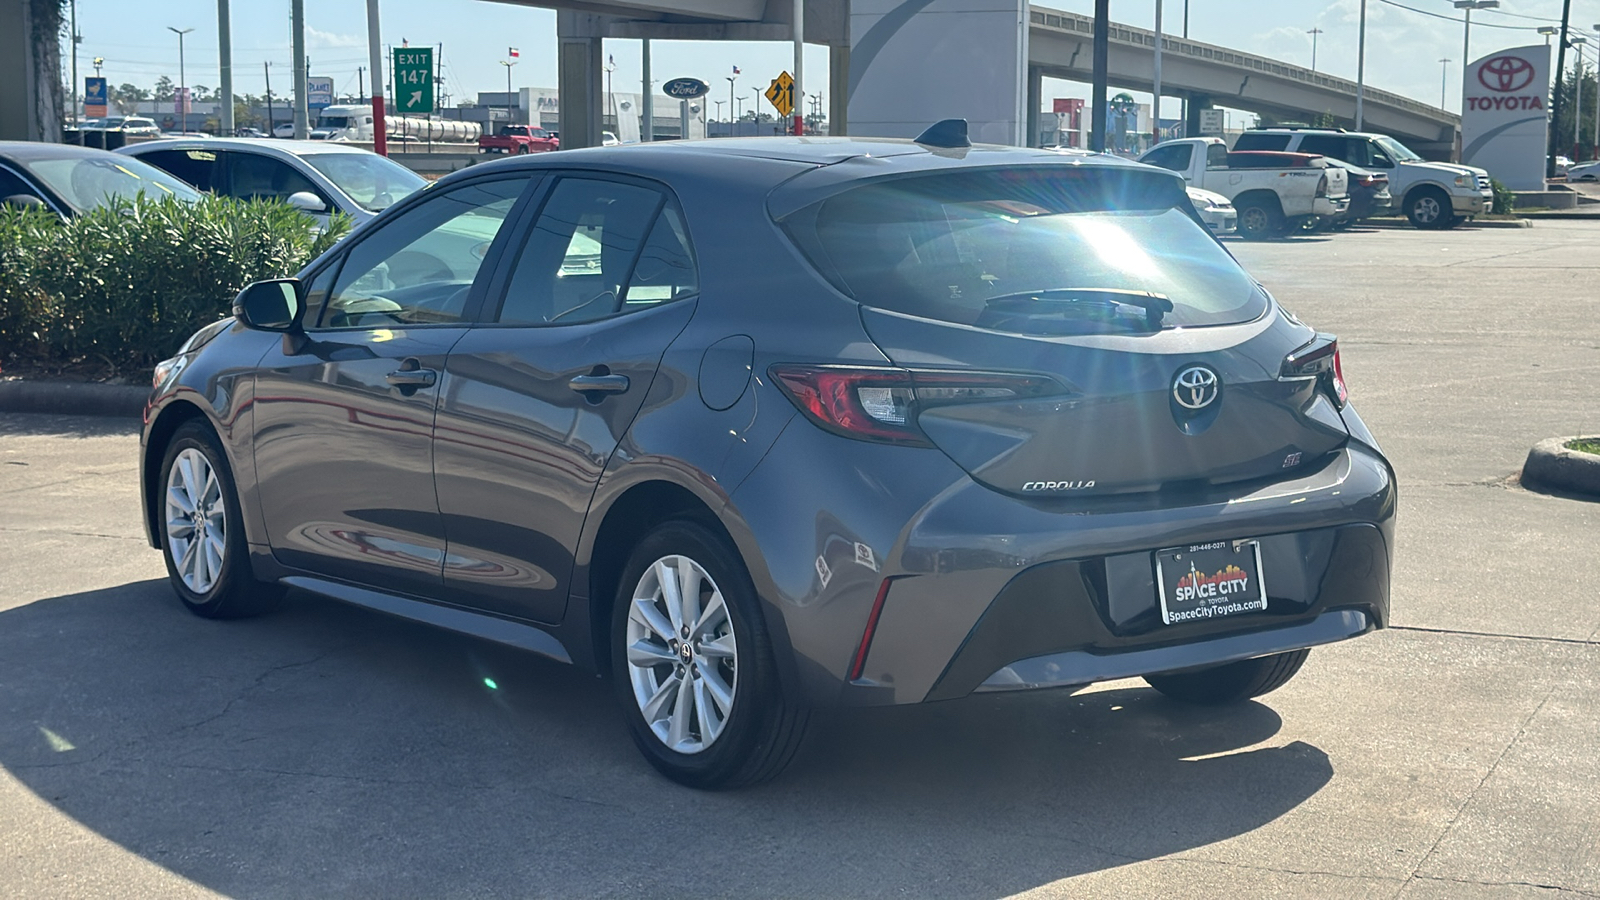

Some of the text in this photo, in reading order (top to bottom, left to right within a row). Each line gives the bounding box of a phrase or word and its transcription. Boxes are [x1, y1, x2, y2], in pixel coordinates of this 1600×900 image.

[399, 54, 427, 65] EXIT
[400, 69, 428, 84] 147
[671, 82, 698, 95] Ford
[1466, 96, 1543, 111] TOYOTA
[1021, 480, 1096, 492] COROLLA
[1175, 578, 1248, 601] SPACE CITY
[1207, 596, 1229, 605] TOYOTA
[1168, 600, 1262, 623] SpaceCityToyota.com
